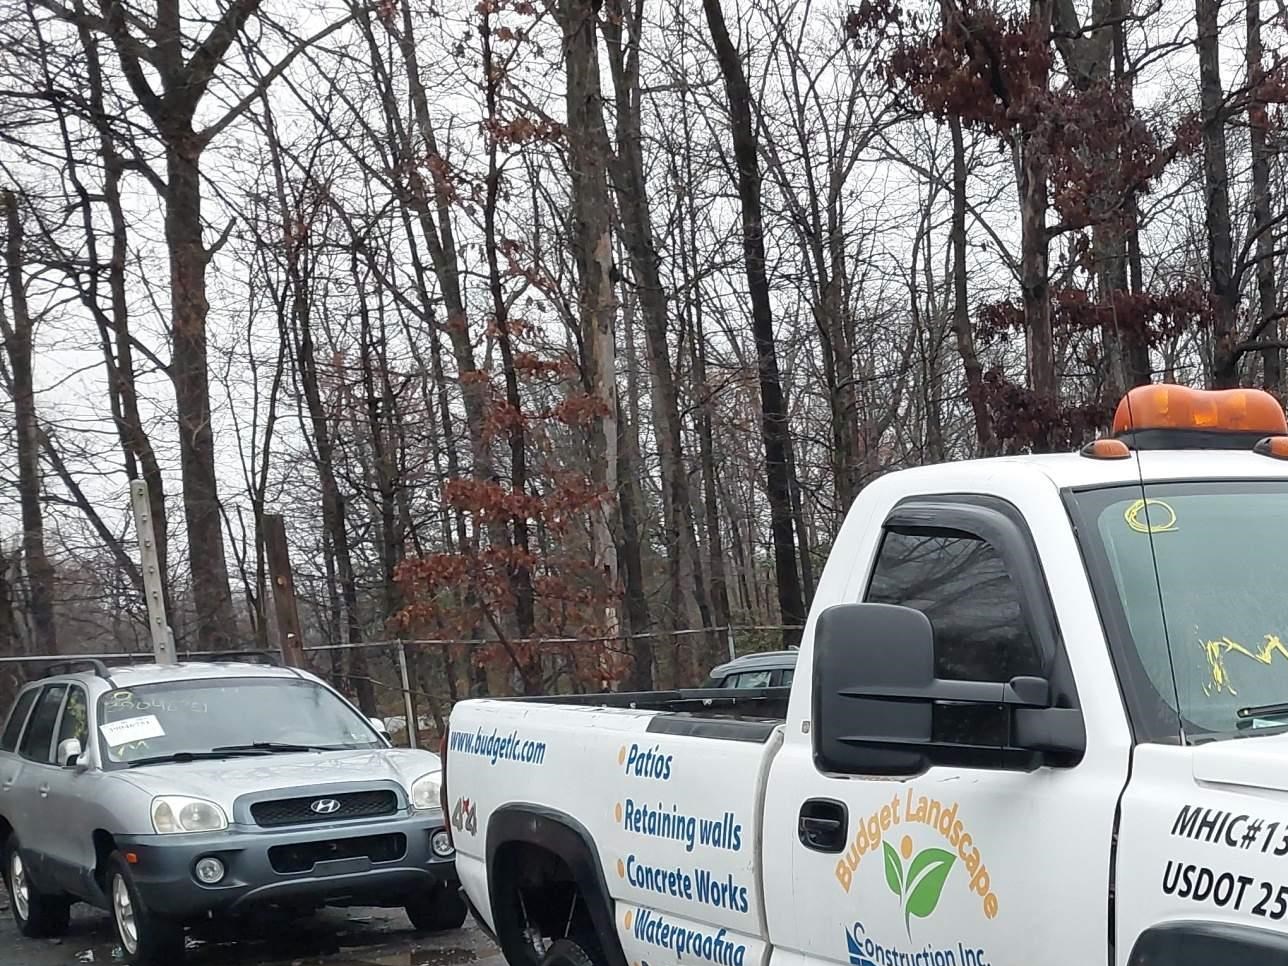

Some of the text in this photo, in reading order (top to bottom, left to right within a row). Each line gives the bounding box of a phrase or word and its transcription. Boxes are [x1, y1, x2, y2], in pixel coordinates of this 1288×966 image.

[450, 726, 546, 765] www.budgetlc.com
[626, 743, 673, 780] Patios
[624, 799, 742, 852] Retaining walls
[835, 787, 999, 920] Budget Landscape
[626, 854, 749, 913] Concrete Works
[1162, 860, 1254, 911] USDOT
